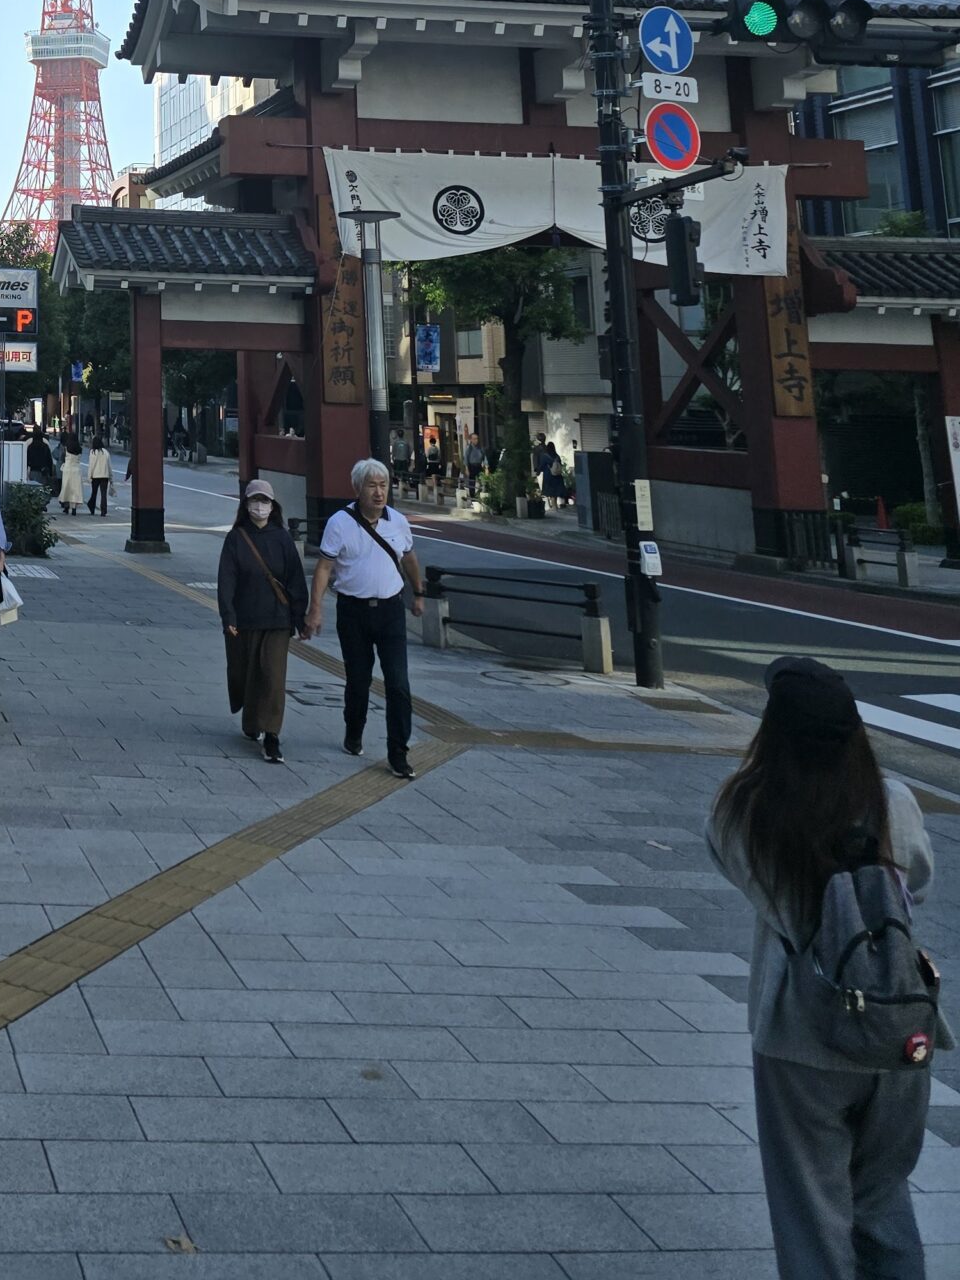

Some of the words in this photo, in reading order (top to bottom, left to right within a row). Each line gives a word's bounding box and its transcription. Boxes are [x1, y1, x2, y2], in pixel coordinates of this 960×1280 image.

[654, 79, 690, 97] 8-20
[16, 310, 33, 332] P
[770, 287, 808, 402] 増上寺
